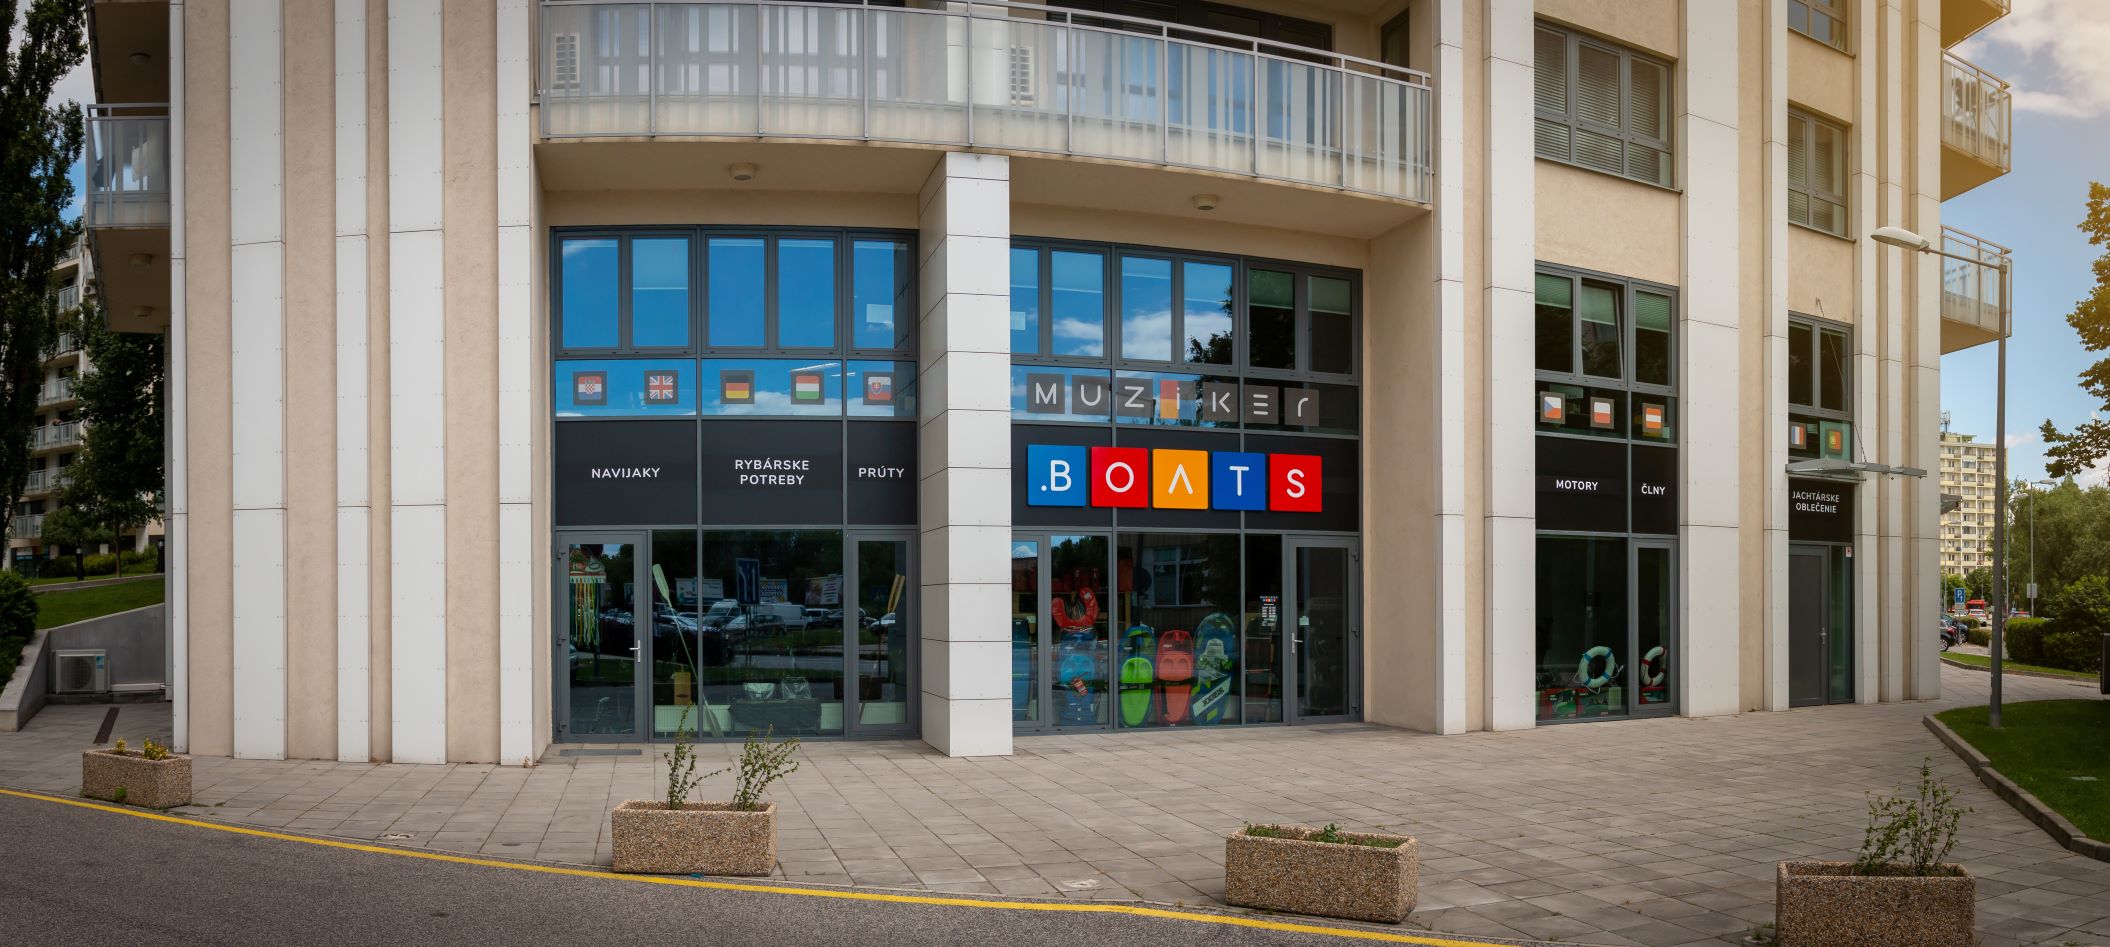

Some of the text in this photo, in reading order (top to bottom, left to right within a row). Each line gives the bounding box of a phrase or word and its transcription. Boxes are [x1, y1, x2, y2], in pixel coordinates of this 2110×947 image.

[735, 457, 810, 471] RYBÁRSKE
[591, 467, 660, 479] NAVIJAKY
[858, 465, 905, 479] PRÚTY
[740, 474, 805, 485] POTREBY
[1556, 479, 1599, 491] MOTORY
[1641, 482, 1666, 496] ČLNY
[1792, 489, 1840, 503] JACHTÁRSKE
[1795, 501, 1837, 514] OBLEČENIE
